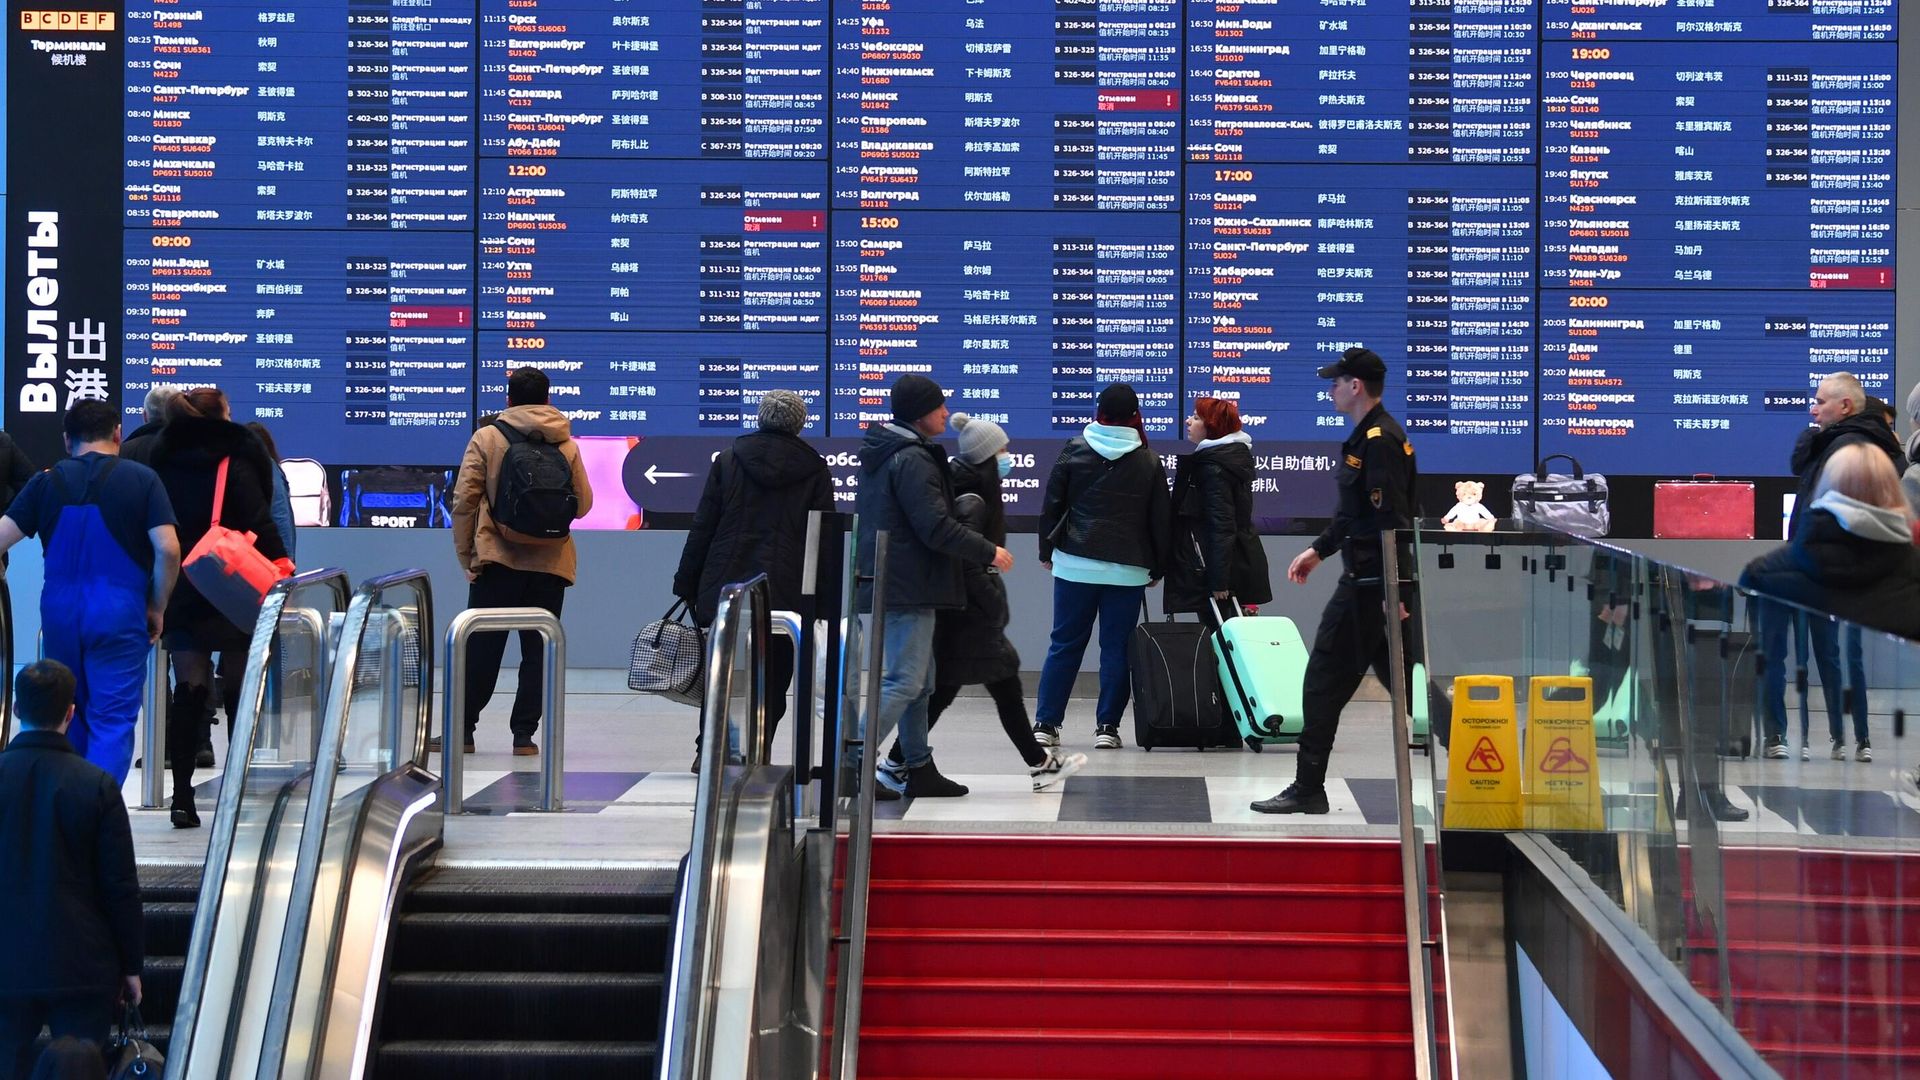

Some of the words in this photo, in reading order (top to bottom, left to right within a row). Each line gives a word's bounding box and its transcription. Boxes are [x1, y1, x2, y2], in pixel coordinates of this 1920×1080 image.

[24, 13, 32, 23] B
[42, 13, 51, 24] C
[61, 13, 71, 24] D
[80, 13, 88, 24] E
[98, 13, 107, 24] F
[127, 11, 152, 19] 08:20
[153, 11, 203, 21] Грозный
[257, 13, 296, 22] 格罗兹尼
[483, 15, 507, 23] 11:15
[508, 15, 537, 25] Орск
[612, 16, 650, 26] 奥尔斯克
[745, 18, 800, 27] Регистрация
[837, 18, 860, 26] 14:25
[860, 17, 885, 29] Уфа
[965, 19, 985, 28] 乌法
[1190, 20, 1214, 28] 16:30
[153, 21, 183, 29] SU1498
[509, 24, 536, 33] FV6063
[538, 25, 566, 33] SU6063
[1215, 20, 1272, 30] Мин.Воды
[1319, 21, 1348, 30] 矿水城
[1571, 21, 1643, 32] Архангельск
[1676, 22, 1743, 32] 阿尔汉格尔斯克
[1215, 29, 1244, 37] SU1302
[127, 36, 152, 44] 08:25
[152, 35, 199, 45] Тюмень
[391, 40, 447, 49] Регистрация
[484, 39, 507, 48] 11:25
[30, 39, 106, 53] Терминалы
[508, 39, 586, 51] Екатеринбург
[612, 41, 659, 51] 叶卡捷琳堡
[861, 42, 924, 53] Чебоксары
[1215, 44, 1291, 55] Калининград
[184, 46, 210, 54] SU6361
[1318, 45, 1366, 55] 加里宁格勒
[1572, 49, 1610, 59] 19:00
[50, 53, 87, 66] 候机楼
[863, 52, 889, 60] DP6807
[892, 52, 920, 60] SU5030
[152, 60, 182, 69] Сочи
[356, 65, 389, 73] 302-310
[836, 67, 860, 75] 14:40
[861, 67, 935, 76] Нижнекамск
[1214, 69, 1261, 79] Саратов
[1545, 71, 1569, 79] 19:00
[1570, 71, 1635, 81] Череповец
[1776, 74, 1809, 82] 311-312
[1216, 79, 1242, 87] FV6491
[1244, 79, 1271, 87] SU6491
[152, 85, 250, 96] Санкт-Петербург
[257, 87, 296, 97] 圣彼得堡
[507, 89, 563, 99] Салехард
[861, 91, 899, 101] Минск
[1097, 94, 1137, 103] Отменен
[1570, 95, 1599, 104] Сочи
[509, 98, 532, 106] YC132
[1675, 96, 1695, 106] 索契
[152, 110, 191, 119] Минск
[860, 116, 928, 127] Ставрополь
[1214, 120, 1314, 129] Петропавловск-Кмч.
[1545, 120, 1569, 129] 19:20
[1569, 120, 1632, 129] Челябинск
[1570, 130, 1599, 138] SU1532
[483, 138, 506, 146] 11:55
[507, 138, 561, 149] Абу-Даби
[710, 142, 742, 150] 367-375
[860, 141, 934, 151] Владикавказ
[1062, 144, 1095, 153] 318-325
[152, 159, 216, 169] Махачкала
[257, 161, 305, 171] 马哈奇卡拉
[508, 166, 547, 176] 12:00
[1569, 170, 1609, 180] Якутск
[1215, 171, 1253, 181] 17:00
[1674, 171, 1713, 181] 雅库茨克
[506, 188, 566, 199] Астрахань
[836, 190, 859, 198] 14:55
[860, 190, 920, 201] Волгоград
[1189, 193, 1212, 201] 17:05
[1213, 193, 1257, 203] Самара
[860, 200, 889, 208] SU1182
[1501, 204, 1524, 212] 11:05
[126, 209, 151, 217] 08:55
[152, 209, 220, 220] Ставрополь
[507, 212, 556, 221] Нальчик
[743, 215, 783, 224] Отменен
[861, 218, 899, 228] 15:00
[1213, 217, 1312, 226] Южно-Сахалинск
[508, 221, 536, 230] DP6901
[539, 222, 566, 230] SU5036
[152, 236, 192, 247] 09:00
[835, 239, 859, 248] 15:00
[859, 240, 903, 251] Самара
[963, 241, 992, 250] 萨马拉
[1544, 244, 1568, 253] 19:55
[1569, 244, 1619, 254] Магадан
[1674, 245, 1703, 255] 马加丹
[482, 261, 506, 270] 12:40
[506, 261, 533, 270] Ухта
[1188, 267, 1211, 275] 17:15
[1212, 266, 1275, 278] Хабаровск
[1568, 269, 1622, 279] Улан-Удэ
[1213, 276, 1243, 285] SU1710
[1809, 272, 1850, 281] Отменен
[126, 283, 150, 291] 09:05
[151, 283, 227, 294] Новосибирск
[355, 287, 387, 295] 326-364
[1213, 291, 1259, 302] Иркутск
[1316, 293, 1364, 302] 伊尔库茨克
[1569, 297, 1608, 307] 20:00
[19, 211, 59, 413] Вылеты
[151, 307, 187, 317] Пенза
[389, 311, 429, 320] Отменен
[506, 310, 547, 320] Казань
[610, 312, 629, 321] 喀山
[859, 314, 940, 324] Магнитогорск
[1568, 319, 1645, 329] Калининград
[507, 338, 545, 348] 13:00
[834, 338, 858, 346] 15:10
[859, 338, 918, 349] Мурманск
[1543, 343, 1567, 353] 20:15
[1567, 343, 1599, 353] Дели
[1673, 345, 1693, 354] 德里
[1187, 365, 1211, 374] 17:50
[1212, 366, 1272, 376] Мурманск
[1542, 418, 1567, 426] 20:30
[1567, 418, 1635, 428] Н.Новгород
[371, 516, 417, 528] SPORT
